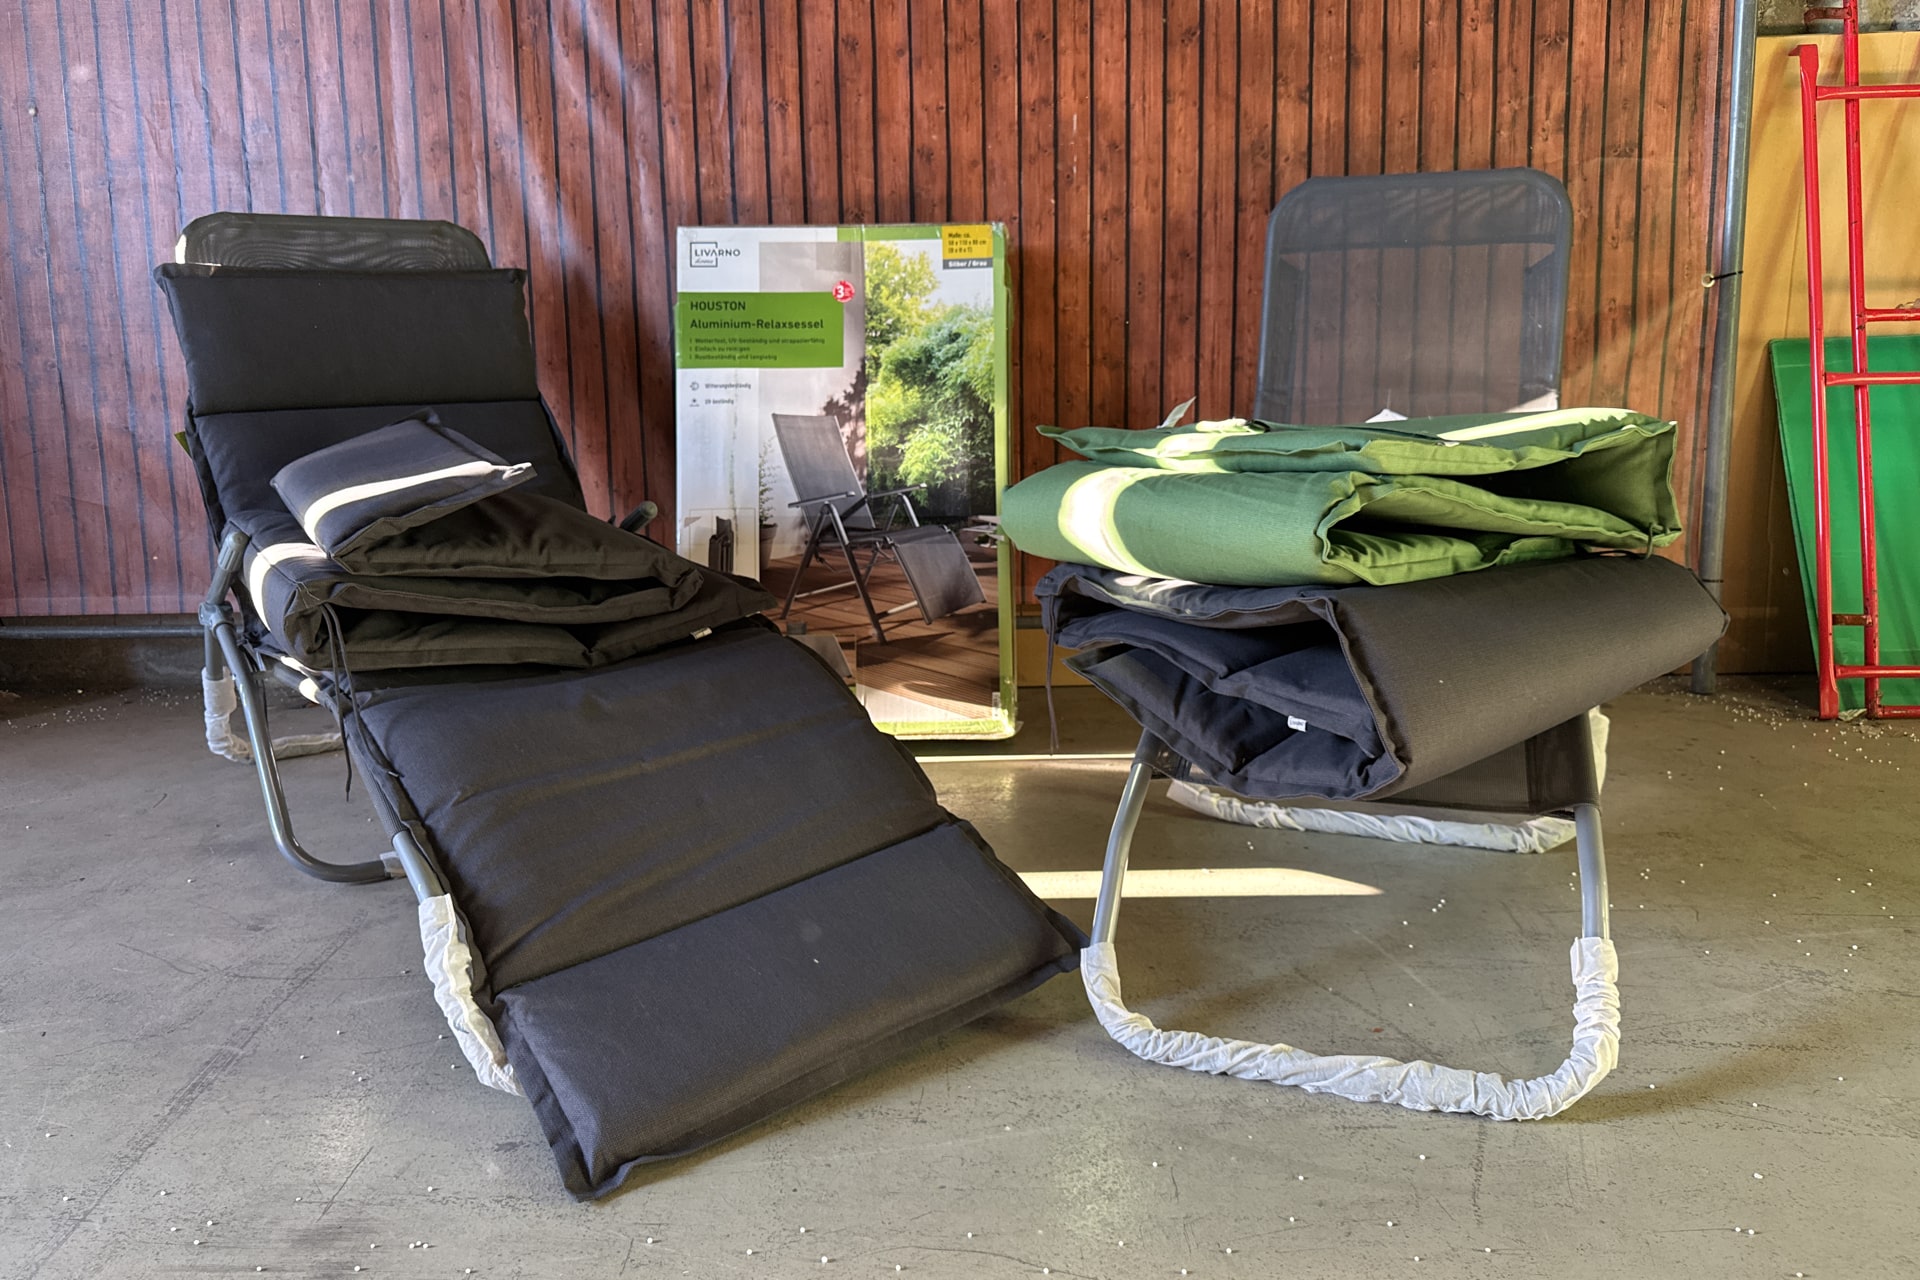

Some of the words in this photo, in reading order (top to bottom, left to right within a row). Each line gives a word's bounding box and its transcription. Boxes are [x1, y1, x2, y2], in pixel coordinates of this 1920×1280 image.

[694, 248, 741, 257] LIVARNO
[836, 285, 844, 298] 3
[690, 301, 746, 311] HOUSTON
[690, 319, 824, 329] Aluminium-Relaxsessel
